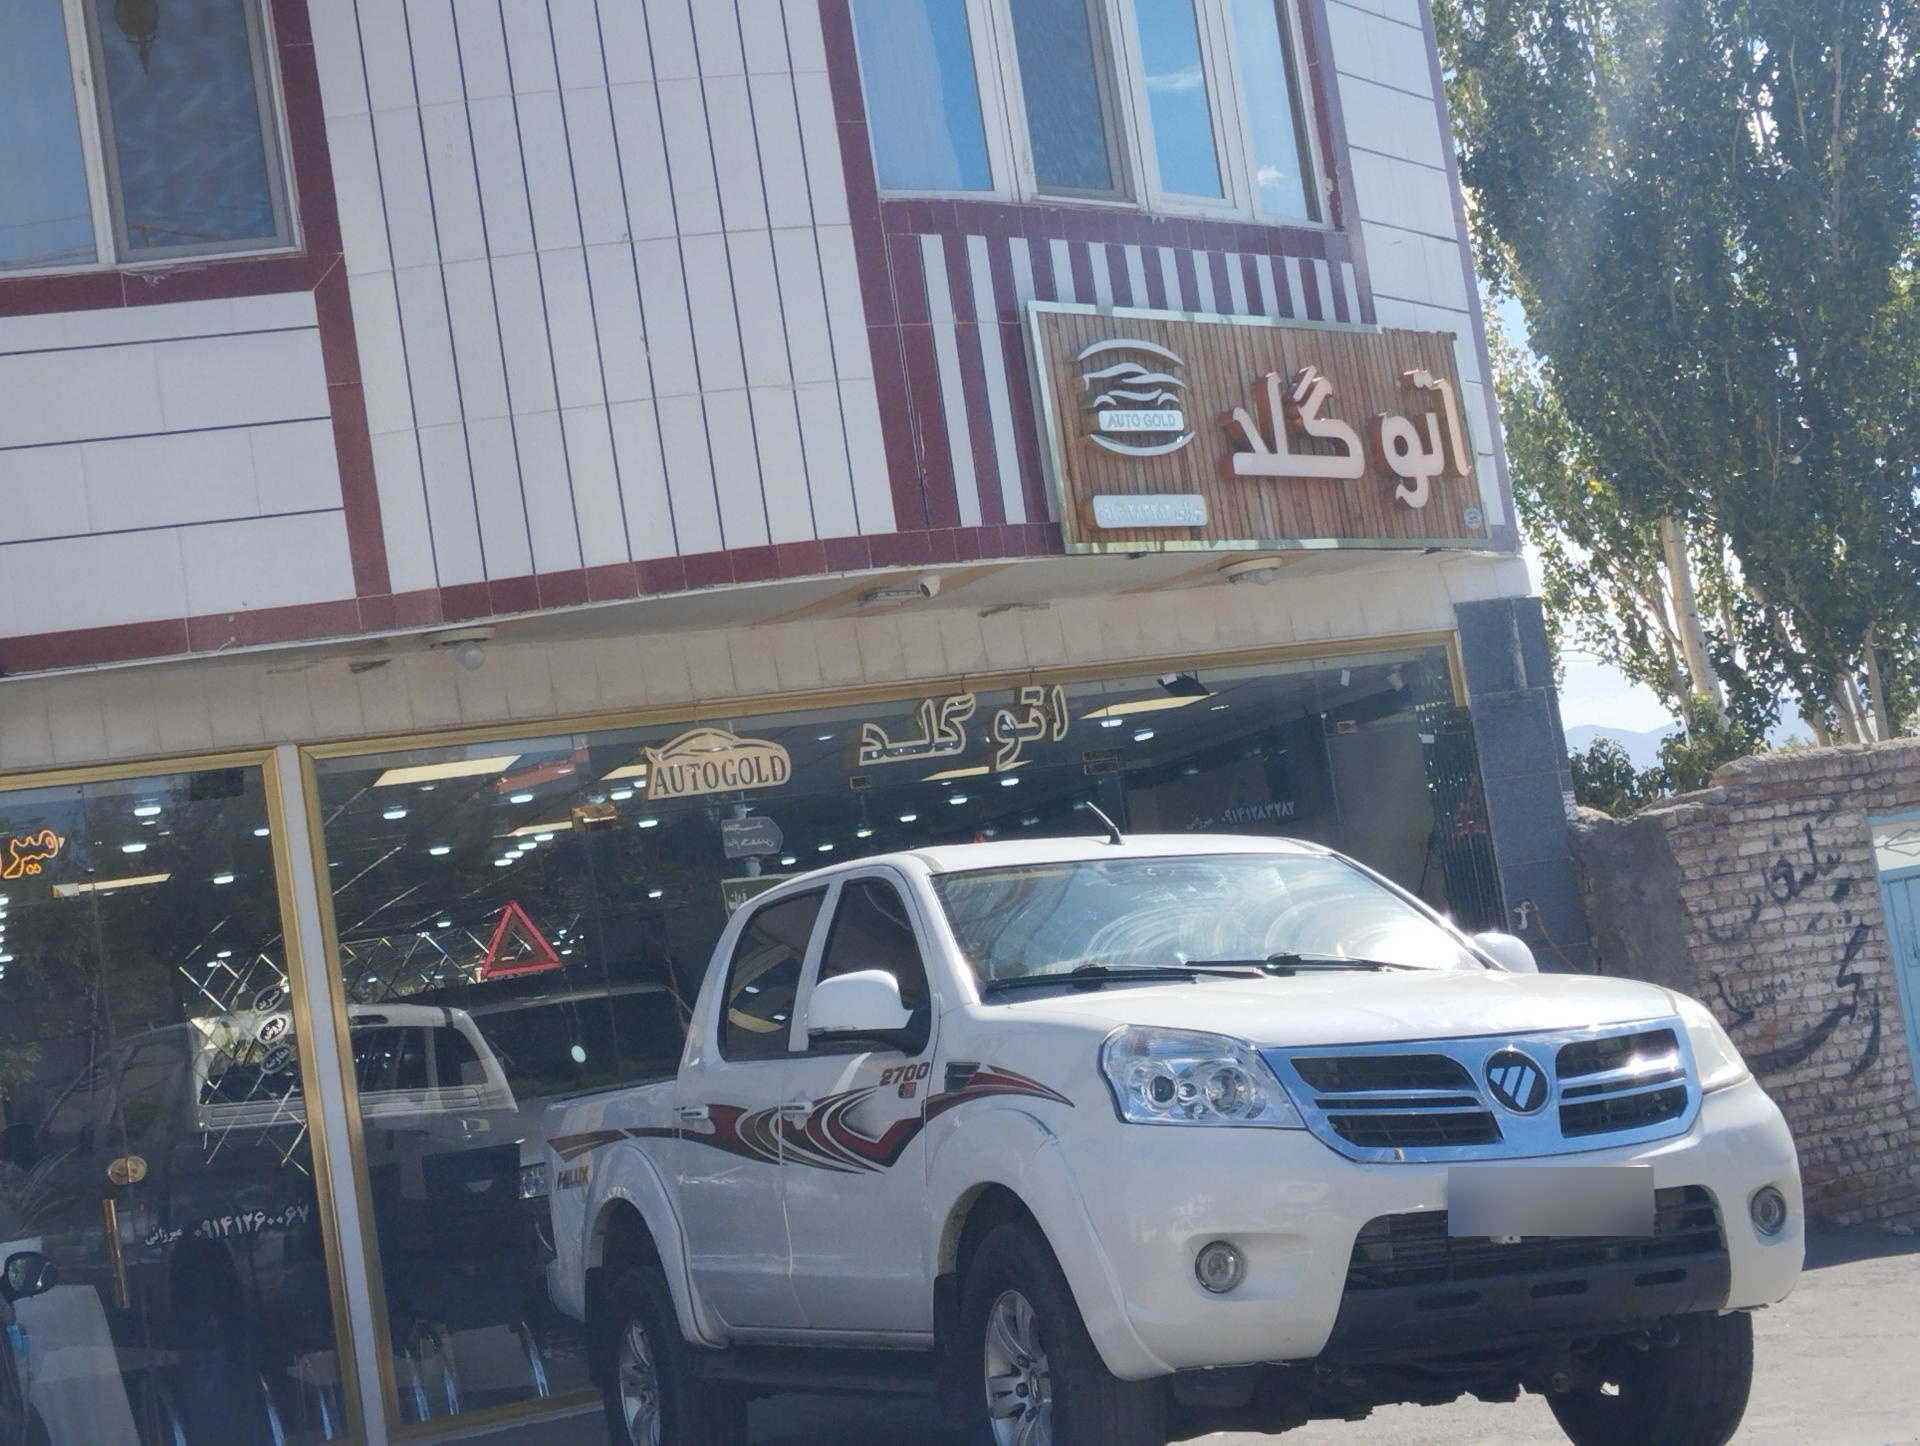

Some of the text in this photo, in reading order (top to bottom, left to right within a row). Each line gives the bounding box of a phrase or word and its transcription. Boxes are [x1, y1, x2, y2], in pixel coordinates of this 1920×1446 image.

[1107, 413, 1176, 428] AUTO GOLD
[1230, 365, 1472, 509] اتو گلد
[858, 684, 1070, 772] اتو گلد
[880, 1061, 931, 1087] 2700
